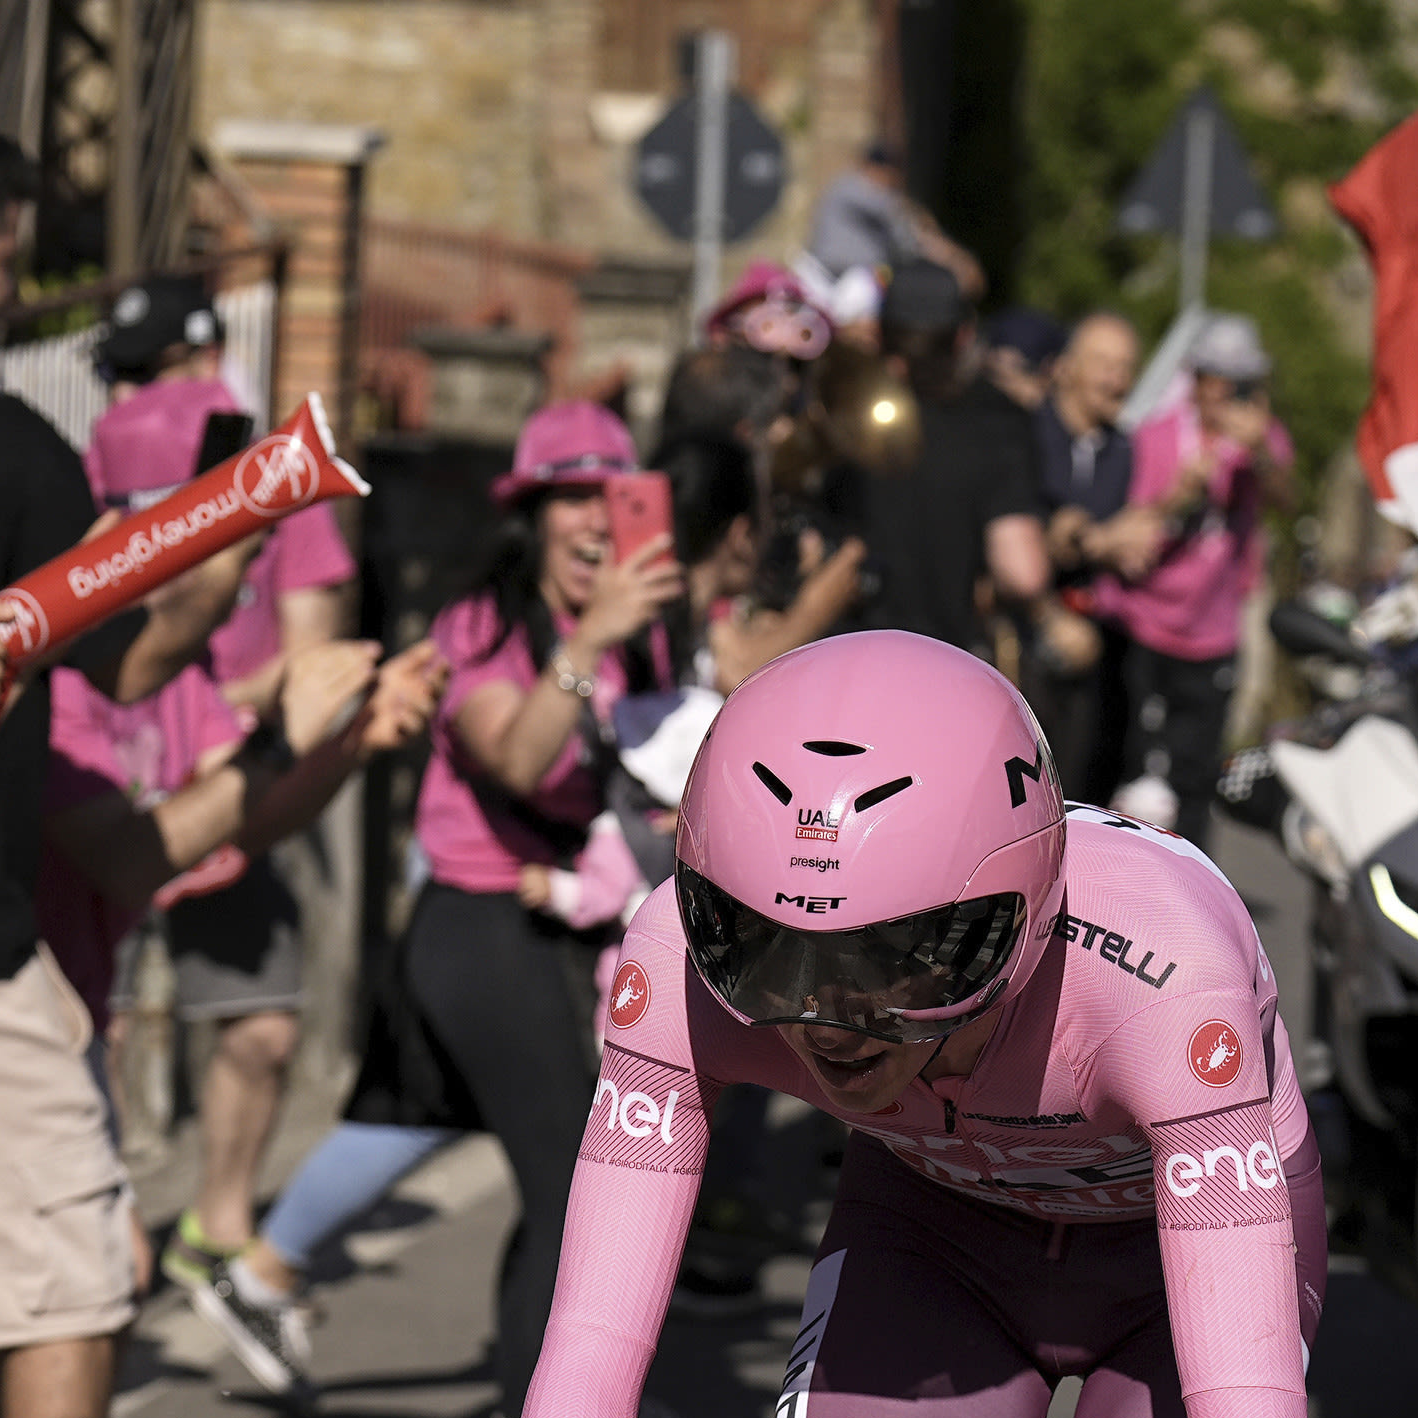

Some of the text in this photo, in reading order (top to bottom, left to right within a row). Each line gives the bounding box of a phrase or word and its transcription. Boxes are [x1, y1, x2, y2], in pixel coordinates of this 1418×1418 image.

[67, 486, 240, 599] moneygiving
[796, 828, 838, 842] Emirates
[790, 856, 840, 873] presight
[775, 892, 847, 914] MET
[586, 1078, 680, 1146] nel
[975, 1113, 1028, 1125] Gazzetta
[1028, 1114, 1057, 1125] dello
[1055, 1111, 1087, 1126] Sport
[608, 1158, 668, 1174] #GIRODITALIA
[1169, 1221, 1228, 1231] #GIRODITALIA
